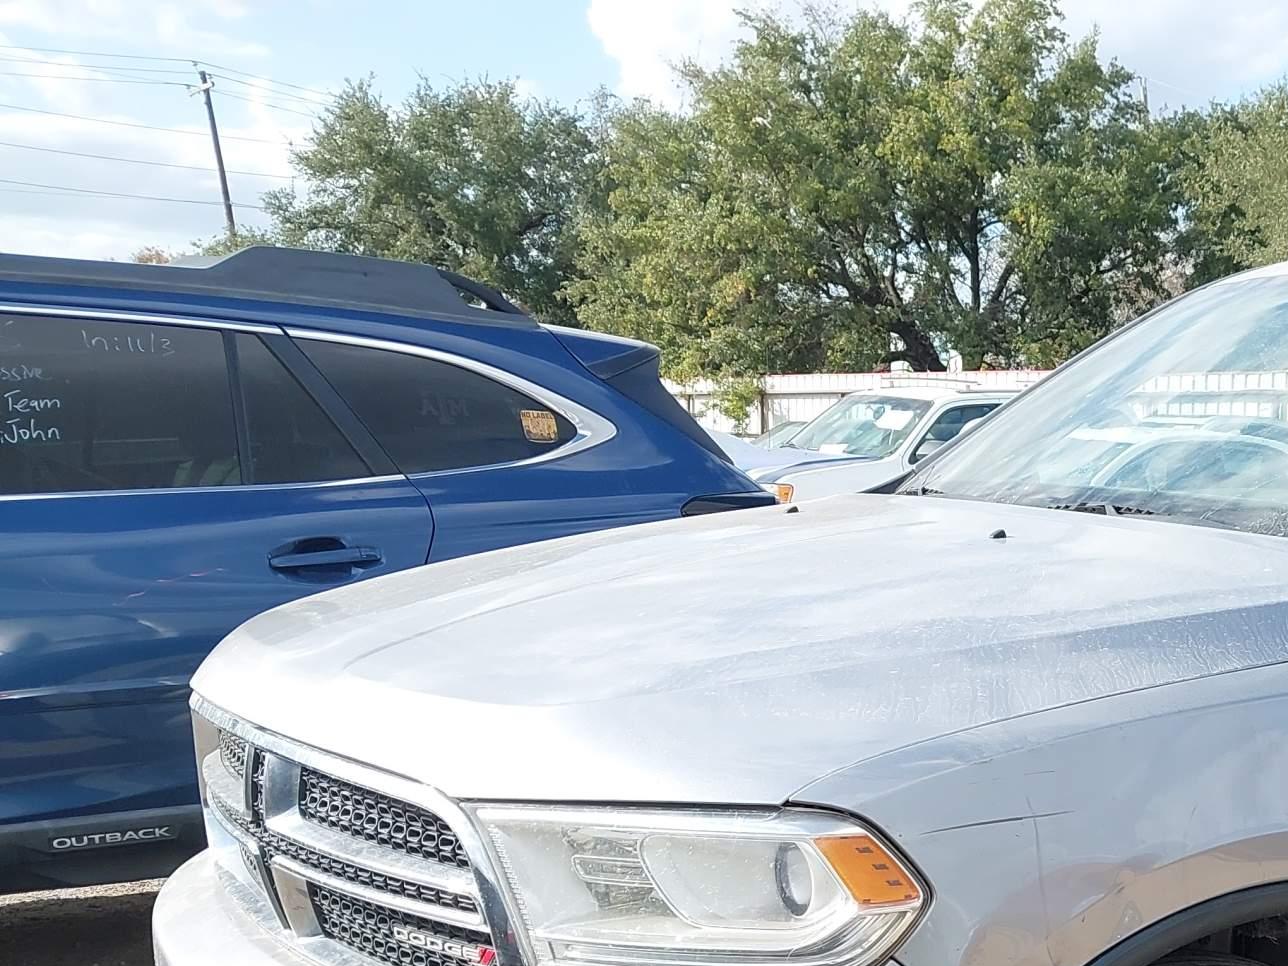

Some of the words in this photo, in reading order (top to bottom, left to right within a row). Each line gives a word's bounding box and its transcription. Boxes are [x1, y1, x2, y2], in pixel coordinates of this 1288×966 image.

[4, 390, 61, 412] Team
[52, 826, 172, 849] OUTBACK
[393, 926, 480, 962] DODGE
